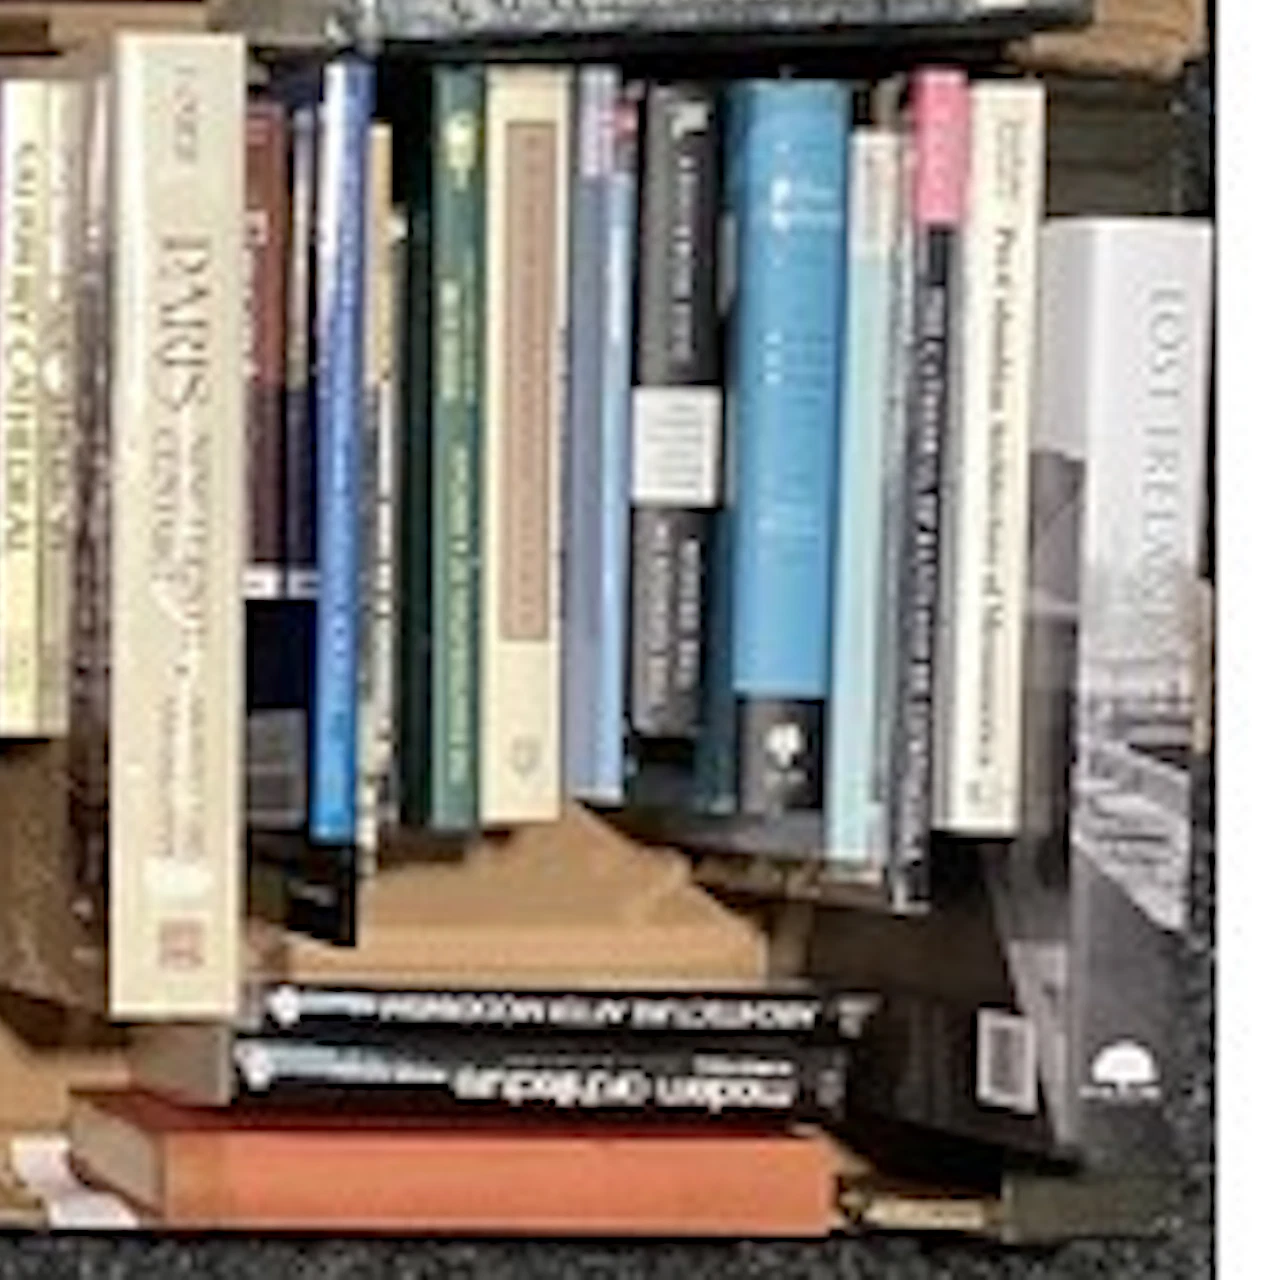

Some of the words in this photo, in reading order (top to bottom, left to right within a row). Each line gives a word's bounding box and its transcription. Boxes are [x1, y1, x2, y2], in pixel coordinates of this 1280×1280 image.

[157, 234, 212, 414] PARIS
[1147, 289, 1189, 399] LOST
[4, 338, 36, 554] CATHEDRAL
[635, 1000, 817, 1030] ARCHITECTURE
[453, 1064, 650, 1111] architecture
[656, 1075, 794, 1111] modern
